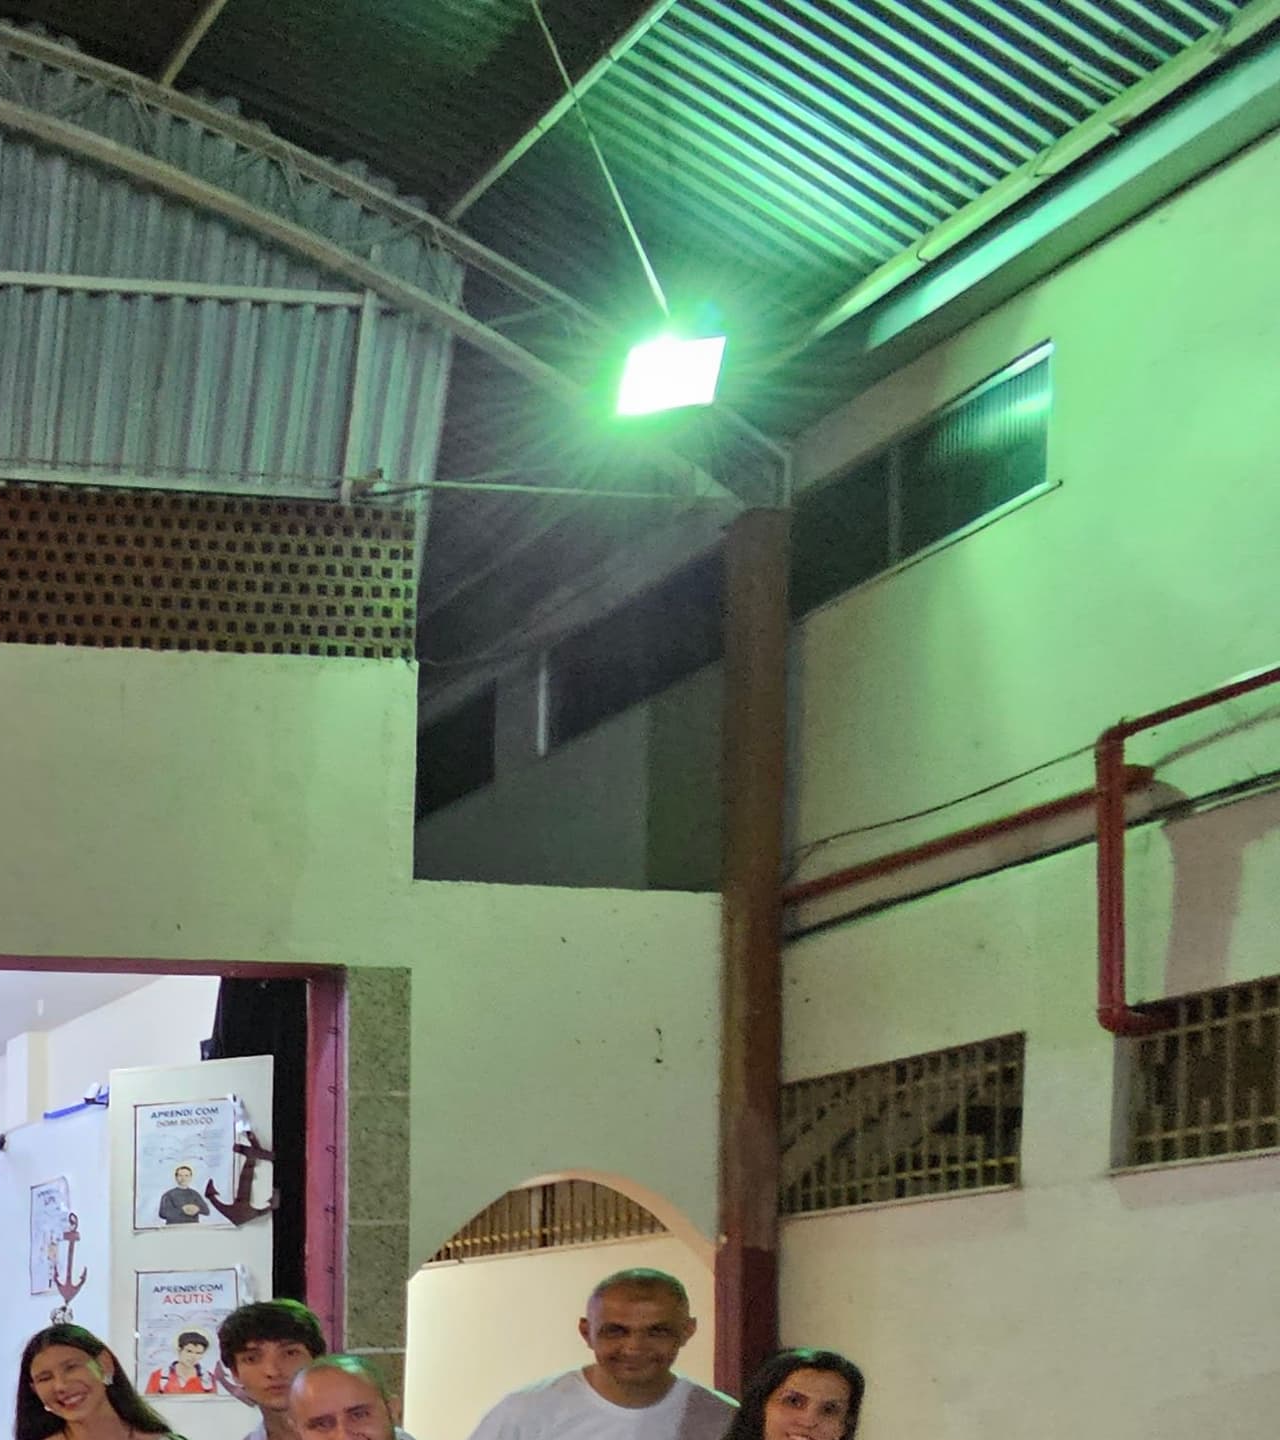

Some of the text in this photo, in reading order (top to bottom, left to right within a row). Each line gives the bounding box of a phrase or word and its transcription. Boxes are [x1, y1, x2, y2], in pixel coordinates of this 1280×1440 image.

[195, 1107, 219, 1116] COM
[199, 1284, 223, 1292] COM
[163, 1293, 214, 1305] ACUTIS
